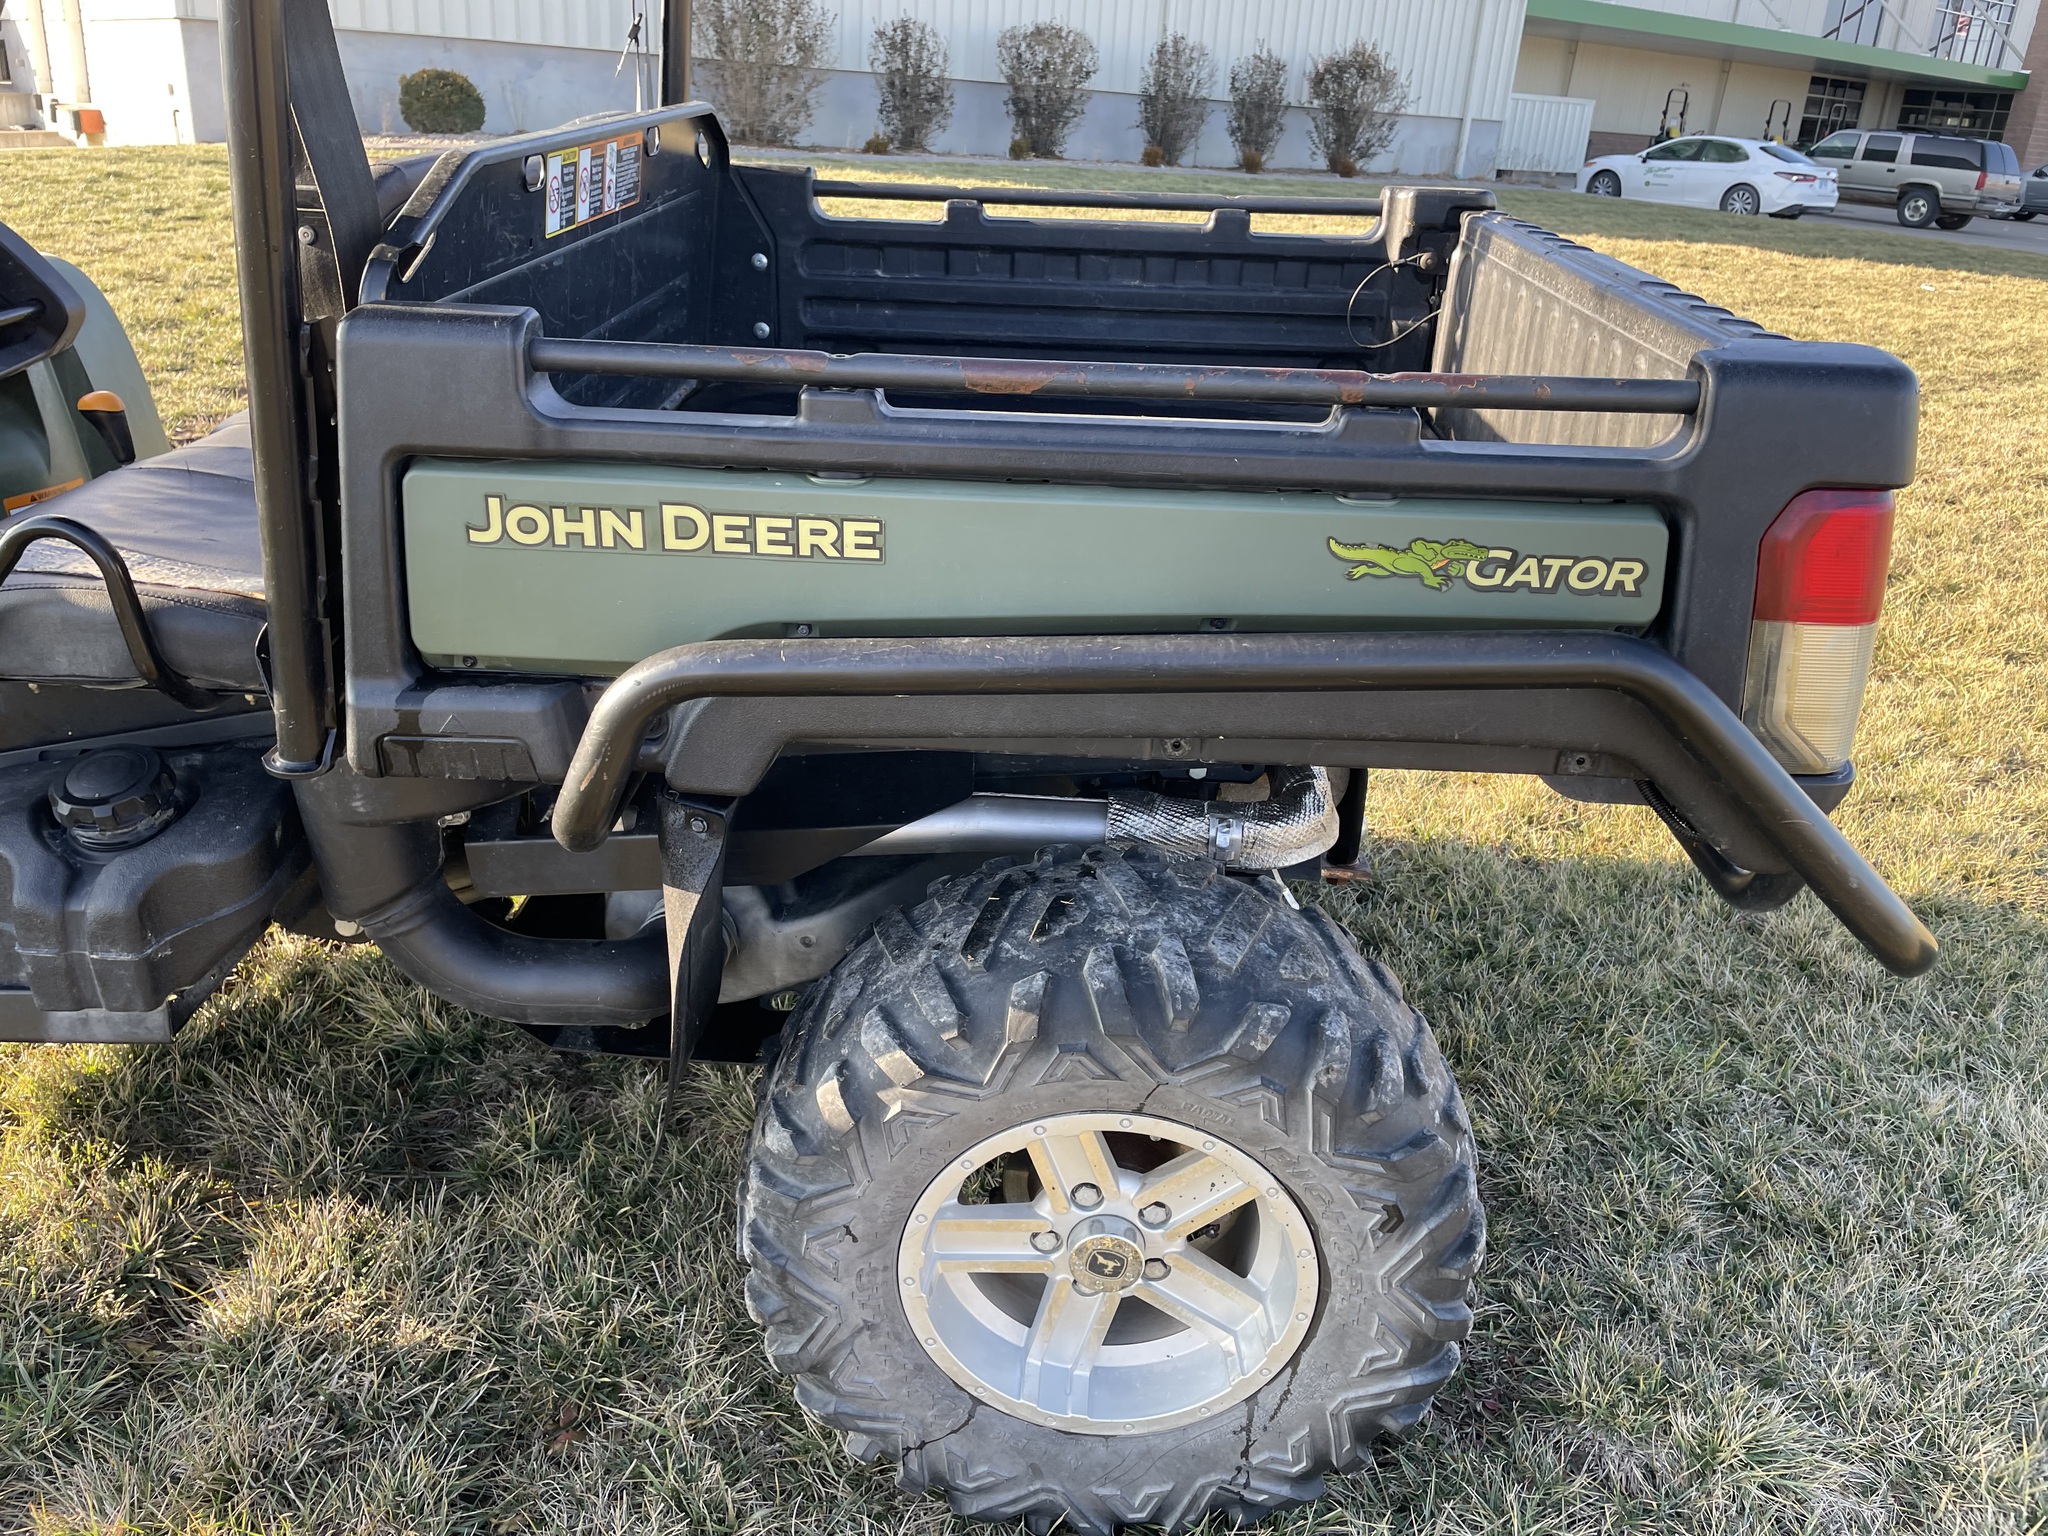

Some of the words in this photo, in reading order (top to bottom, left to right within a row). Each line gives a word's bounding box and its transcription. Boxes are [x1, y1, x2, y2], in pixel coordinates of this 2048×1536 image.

[467, 495, 645, 550] JOHN
[661, 503, 881, 560] DEERE
[1464, 549, 1645, 593] GATOR
